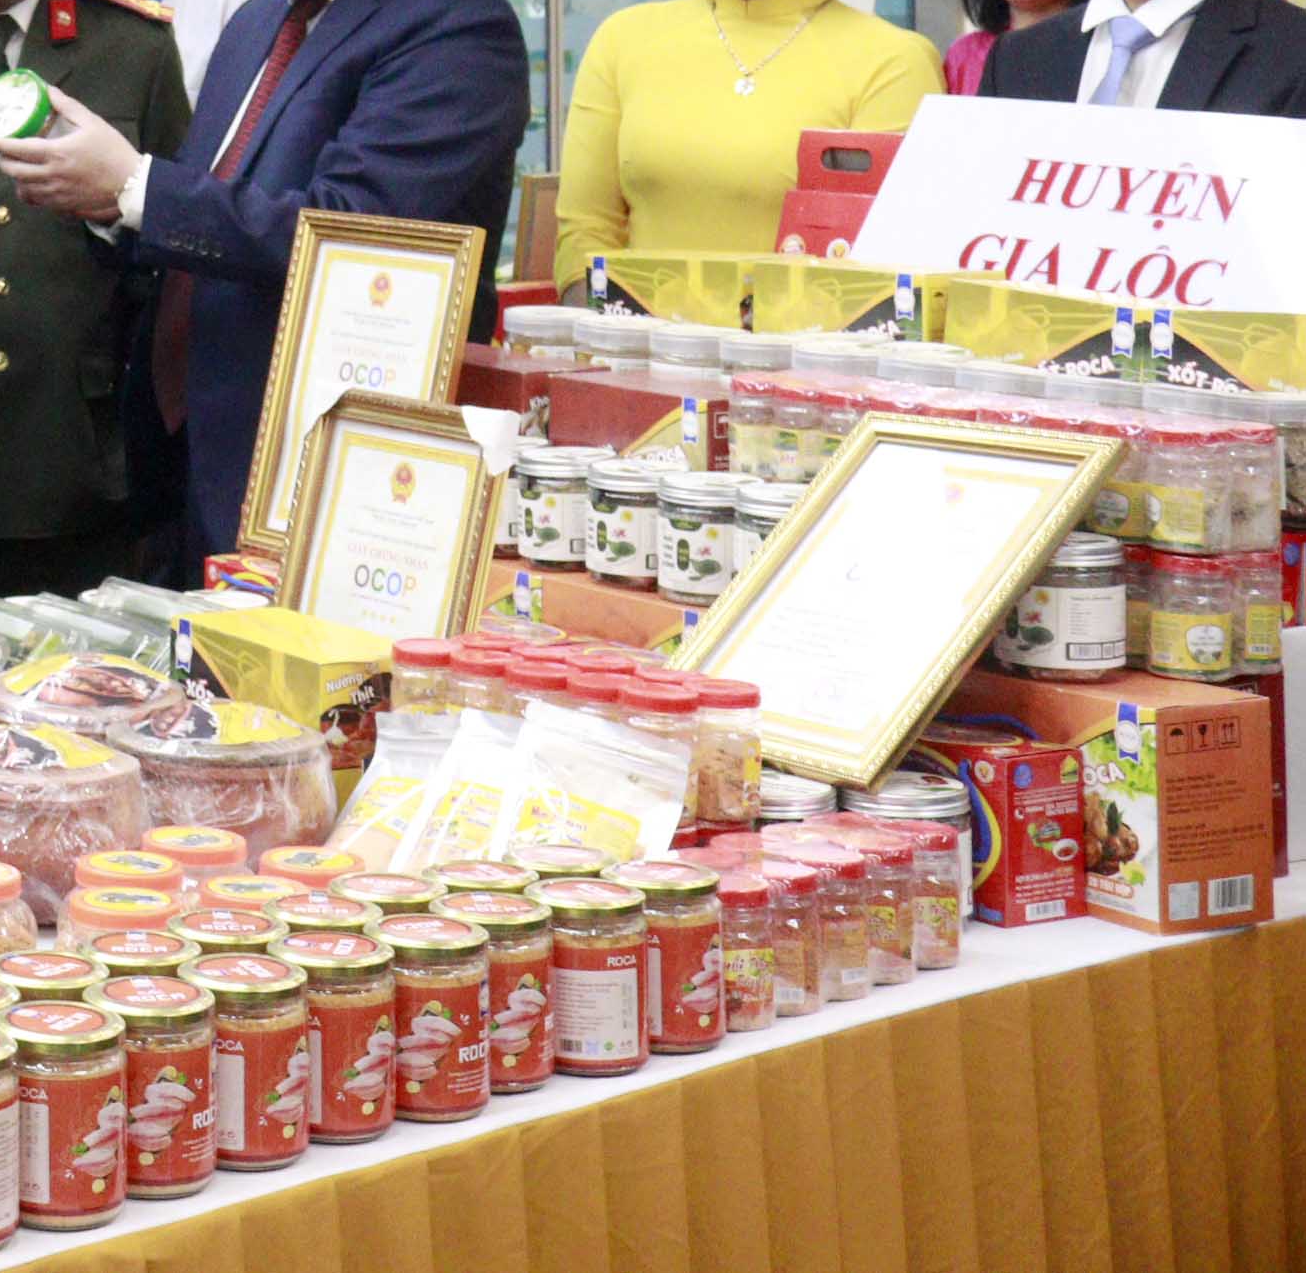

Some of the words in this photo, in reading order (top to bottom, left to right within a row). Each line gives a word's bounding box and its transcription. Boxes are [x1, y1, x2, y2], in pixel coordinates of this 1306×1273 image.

[1007, 157, 1250, 231] HUYỆN
[958, 233, 1061, 286] GIA
[339, 360, 398, 389] OCOP
[354, 563, 417, 598] OCOP
[1082, 761, 1126, 787] OCA
[606, 955, 637, 968] ROCA
